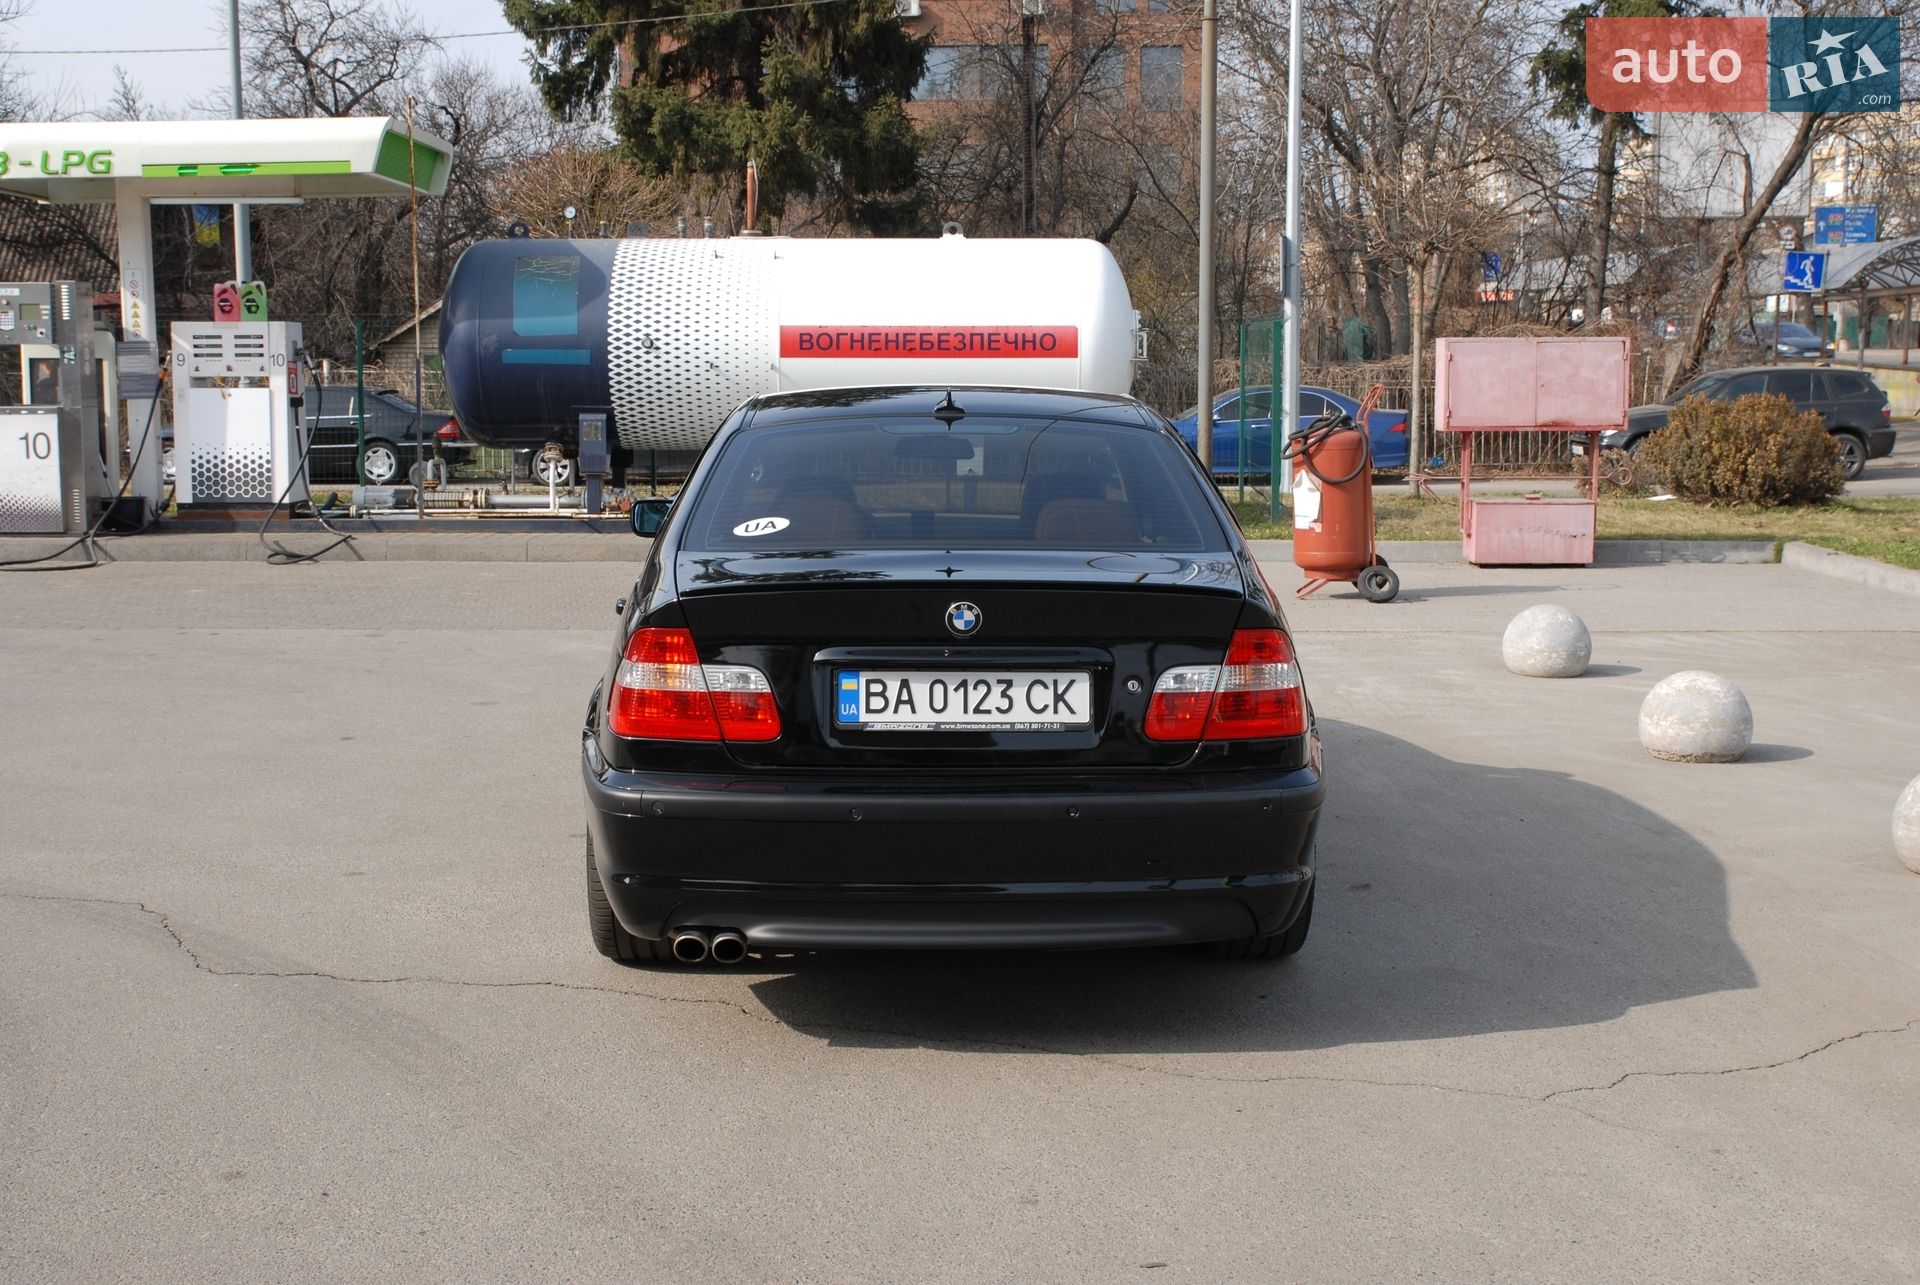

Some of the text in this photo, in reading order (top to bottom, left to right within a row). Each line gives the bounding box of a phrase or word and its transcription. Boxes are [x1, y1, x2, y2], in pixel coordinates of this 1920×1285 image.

[40, 150, 113, 175] LPG
[799, 332, 1057, 352] ВОГНЕНЕБЕЗПЕЧНО
[176, 353, 186, 367] 9
[270, 353, 286, 368] 10
[19, 431, 51, 460] 10
[744, 520, 777, 533] UA
[864, 678, 1077, 715] BA 0123 CK
[841, 703, 857, 716] UA
